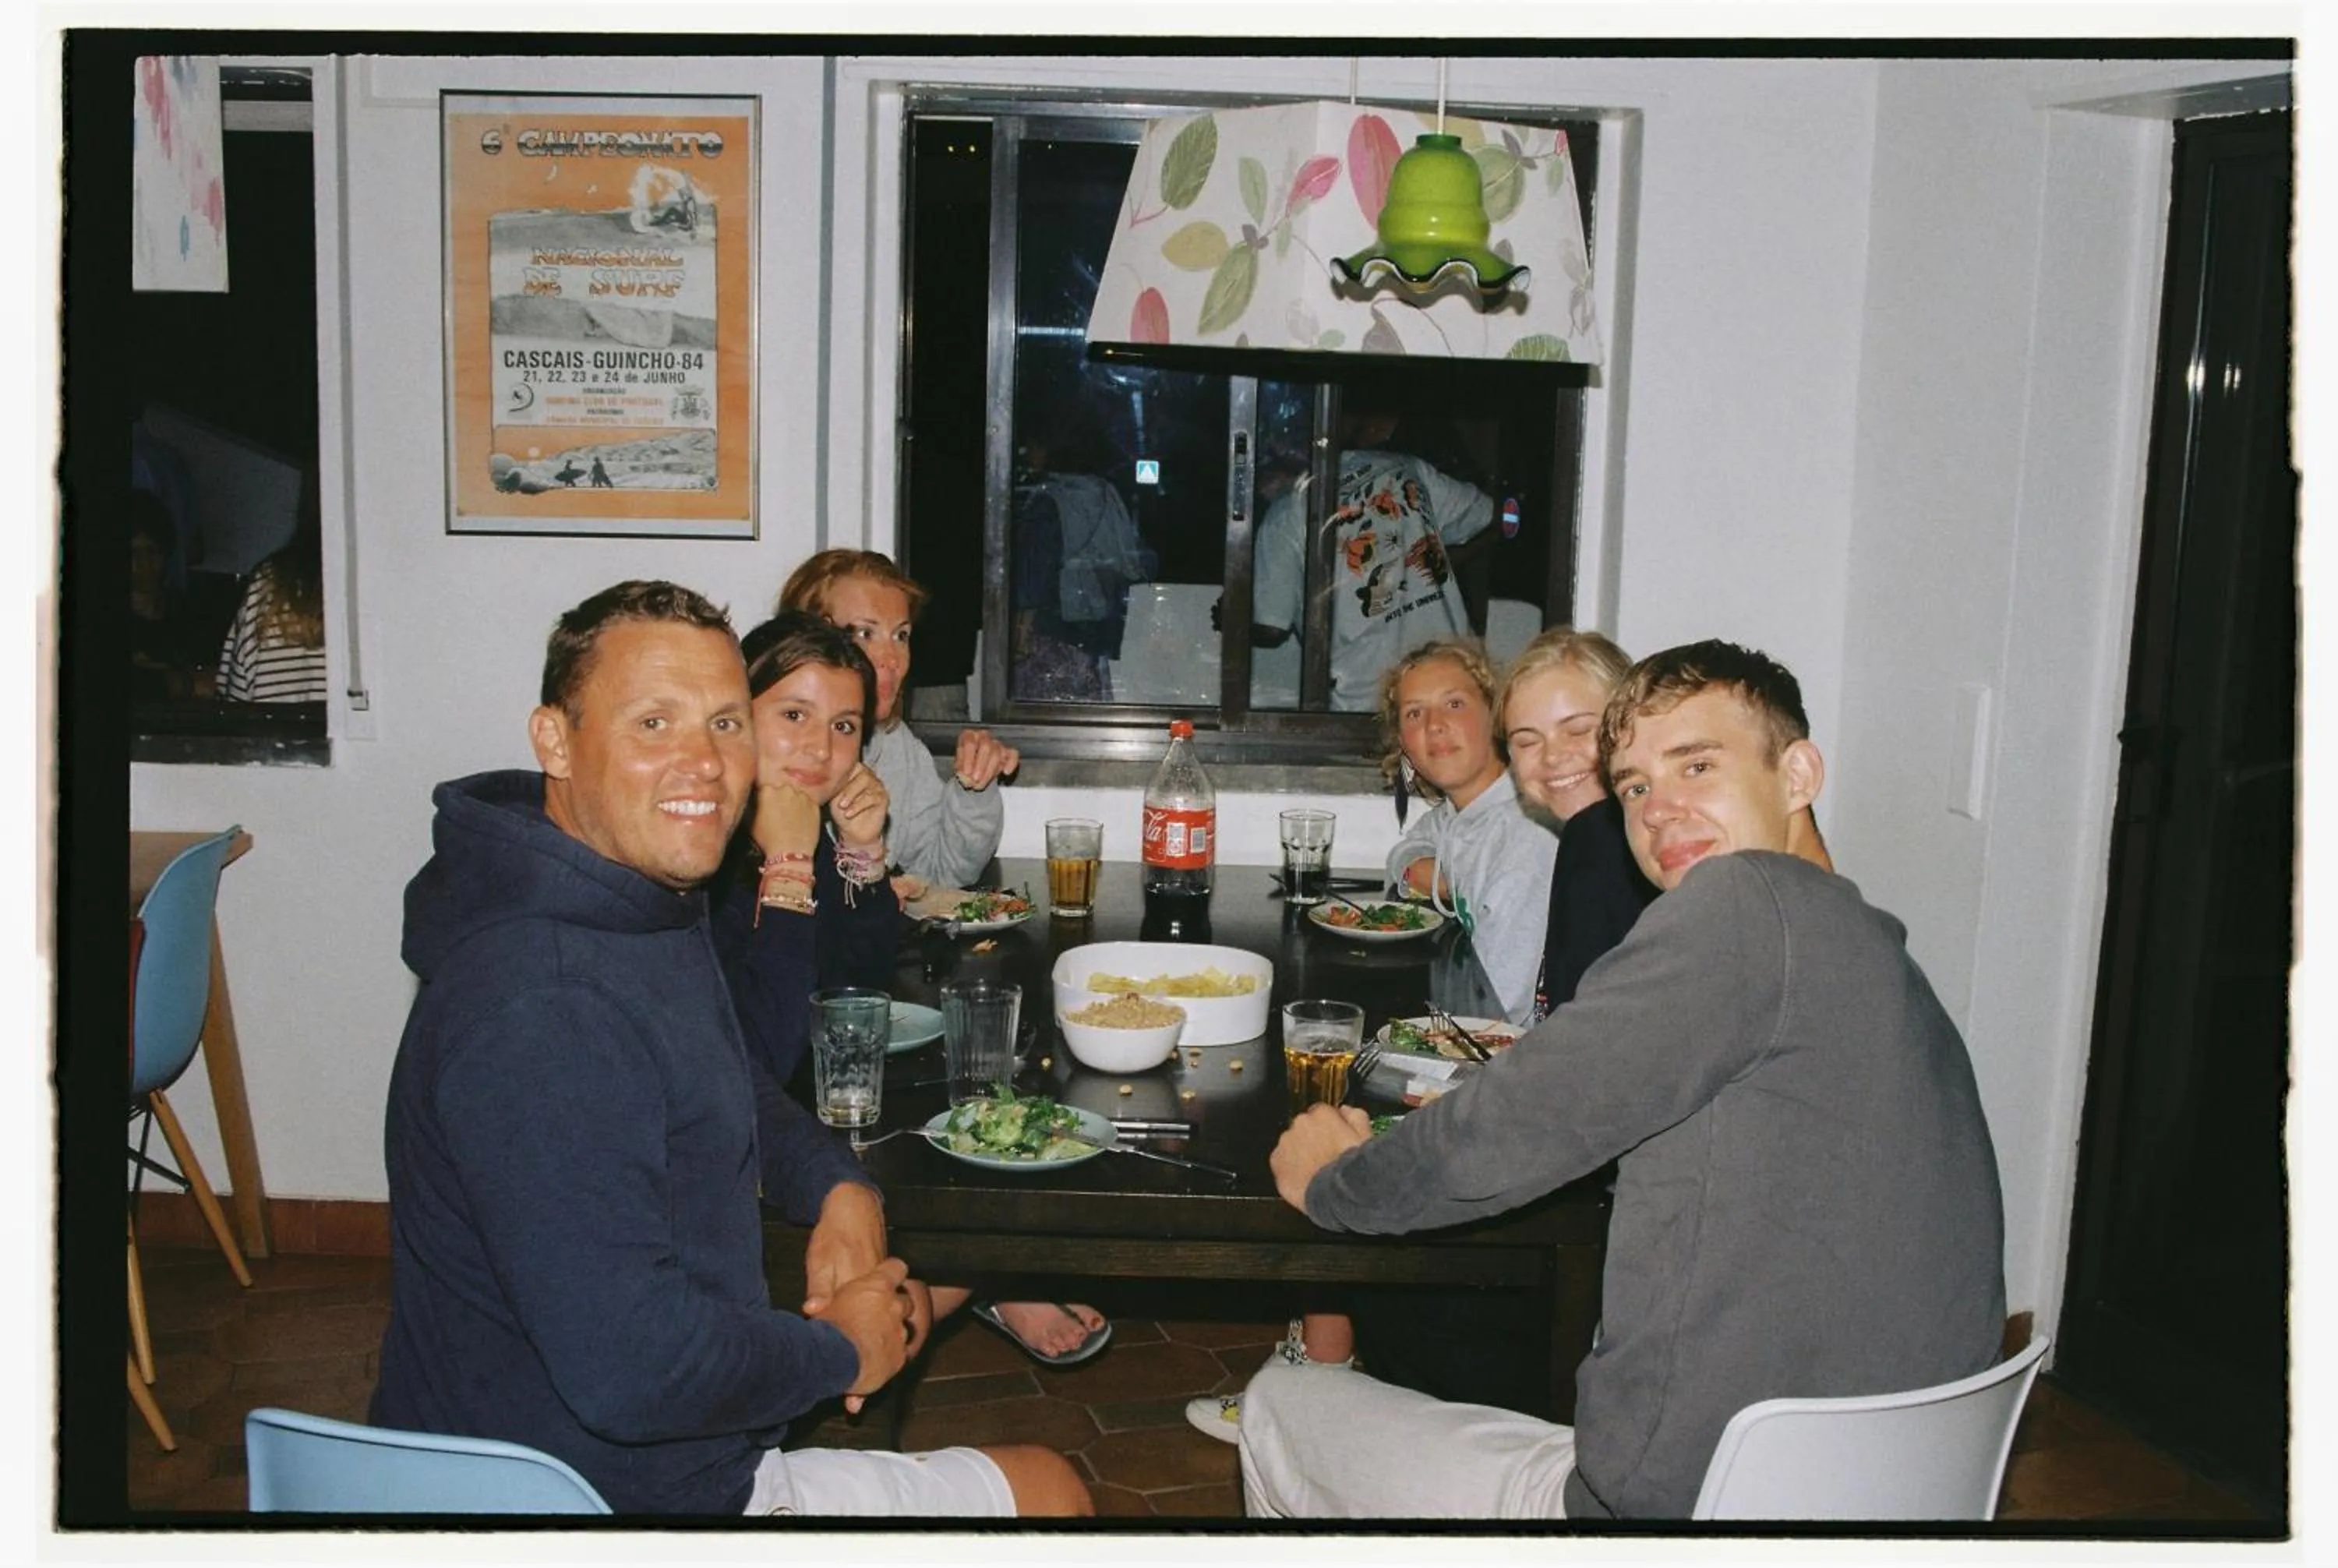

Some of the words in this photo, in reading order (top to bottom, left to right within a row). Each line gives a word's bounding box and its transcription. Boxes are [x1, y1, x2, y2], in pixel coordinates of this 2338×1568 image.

[517, 129, 724, 157] CAMPEONATO
[532, 247, 683, 266] NACIONAL
[523, 267, 562, 297] DE
[588, 268, 686, 298] SURF
[571, 371, 586, 383] 23
[592, 373, 599, 383] e
[604, 371, 619, 383] 24
[624, 371, 638, 383] de
[643, 371, 686, 384] JUNHO
